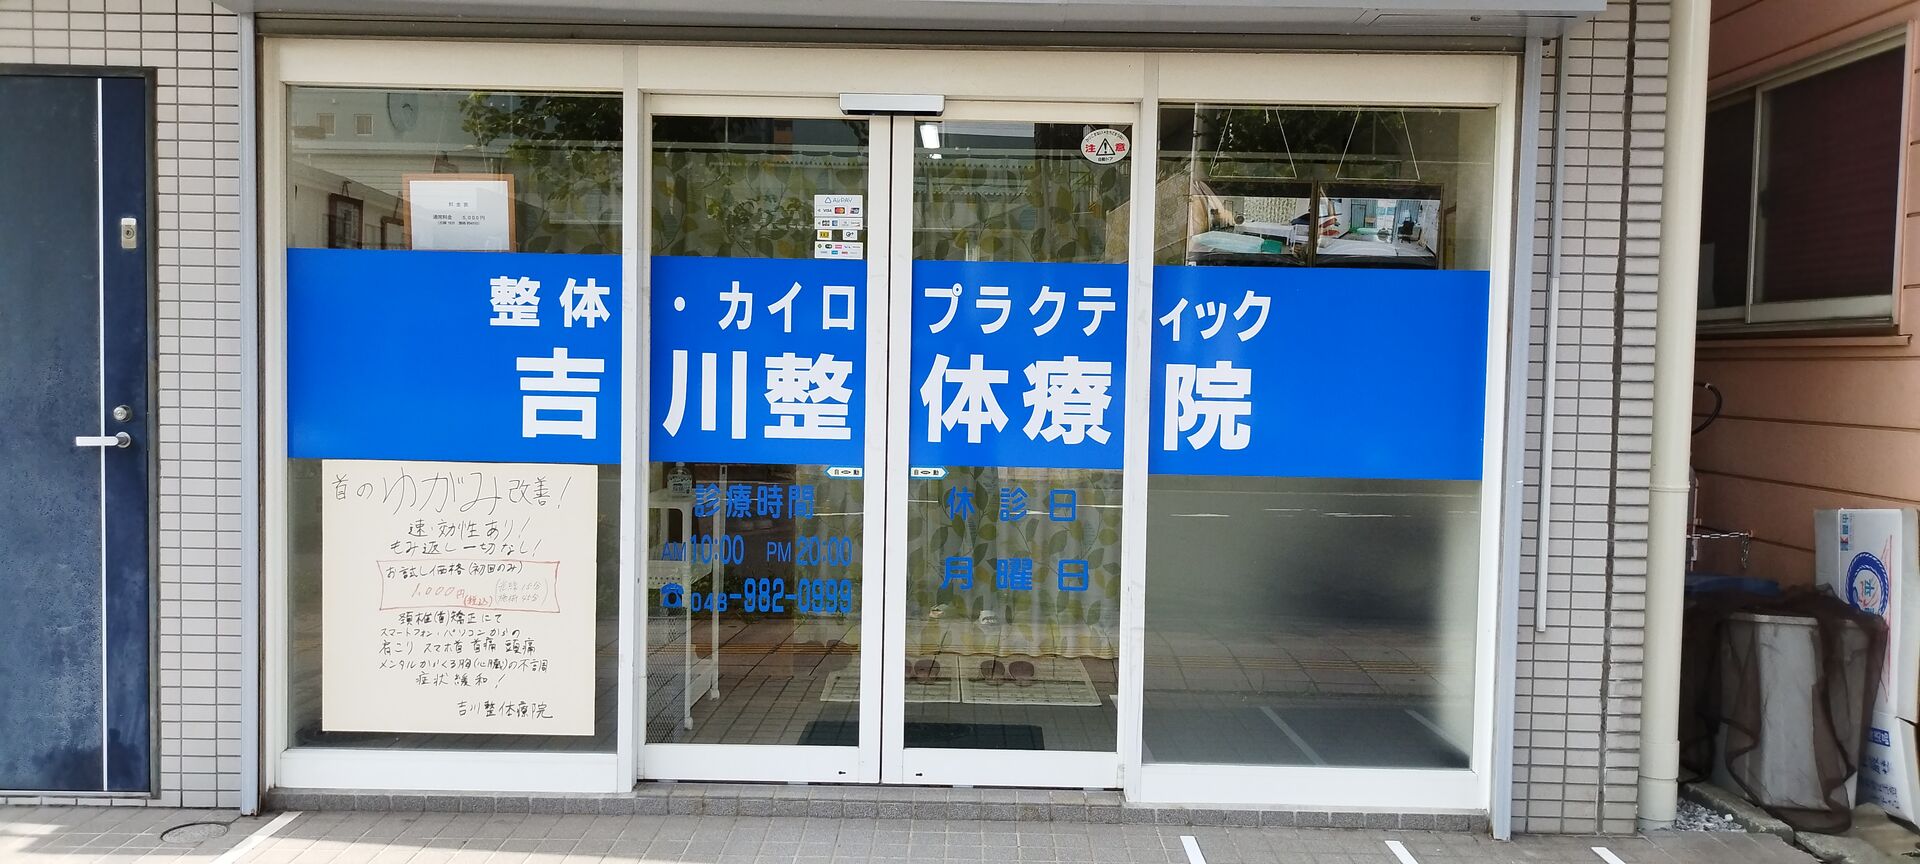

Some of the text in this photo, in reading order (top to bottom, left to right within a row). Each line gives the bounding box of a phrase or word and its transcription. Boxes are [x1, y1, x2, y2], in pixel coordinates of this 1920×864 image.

[1085, 143, 1125, 153] 注意
[517, 348, 1251, 450] 吉川整体療院
[694, 484, 814, 519] 診療時間
[947, 487, 1077, 522] 休診日
[662, 535, 852, 567] AM 10:00 PM 20:00
[941, 557, 1089, 592] 月曜日
[691, 578, 852, 613] 048-982-0999
[379, 637, 537, 656] 肩こり スマホ首 首痛 頭痛
[457, 700, 554, 719] 吉川整体療院
